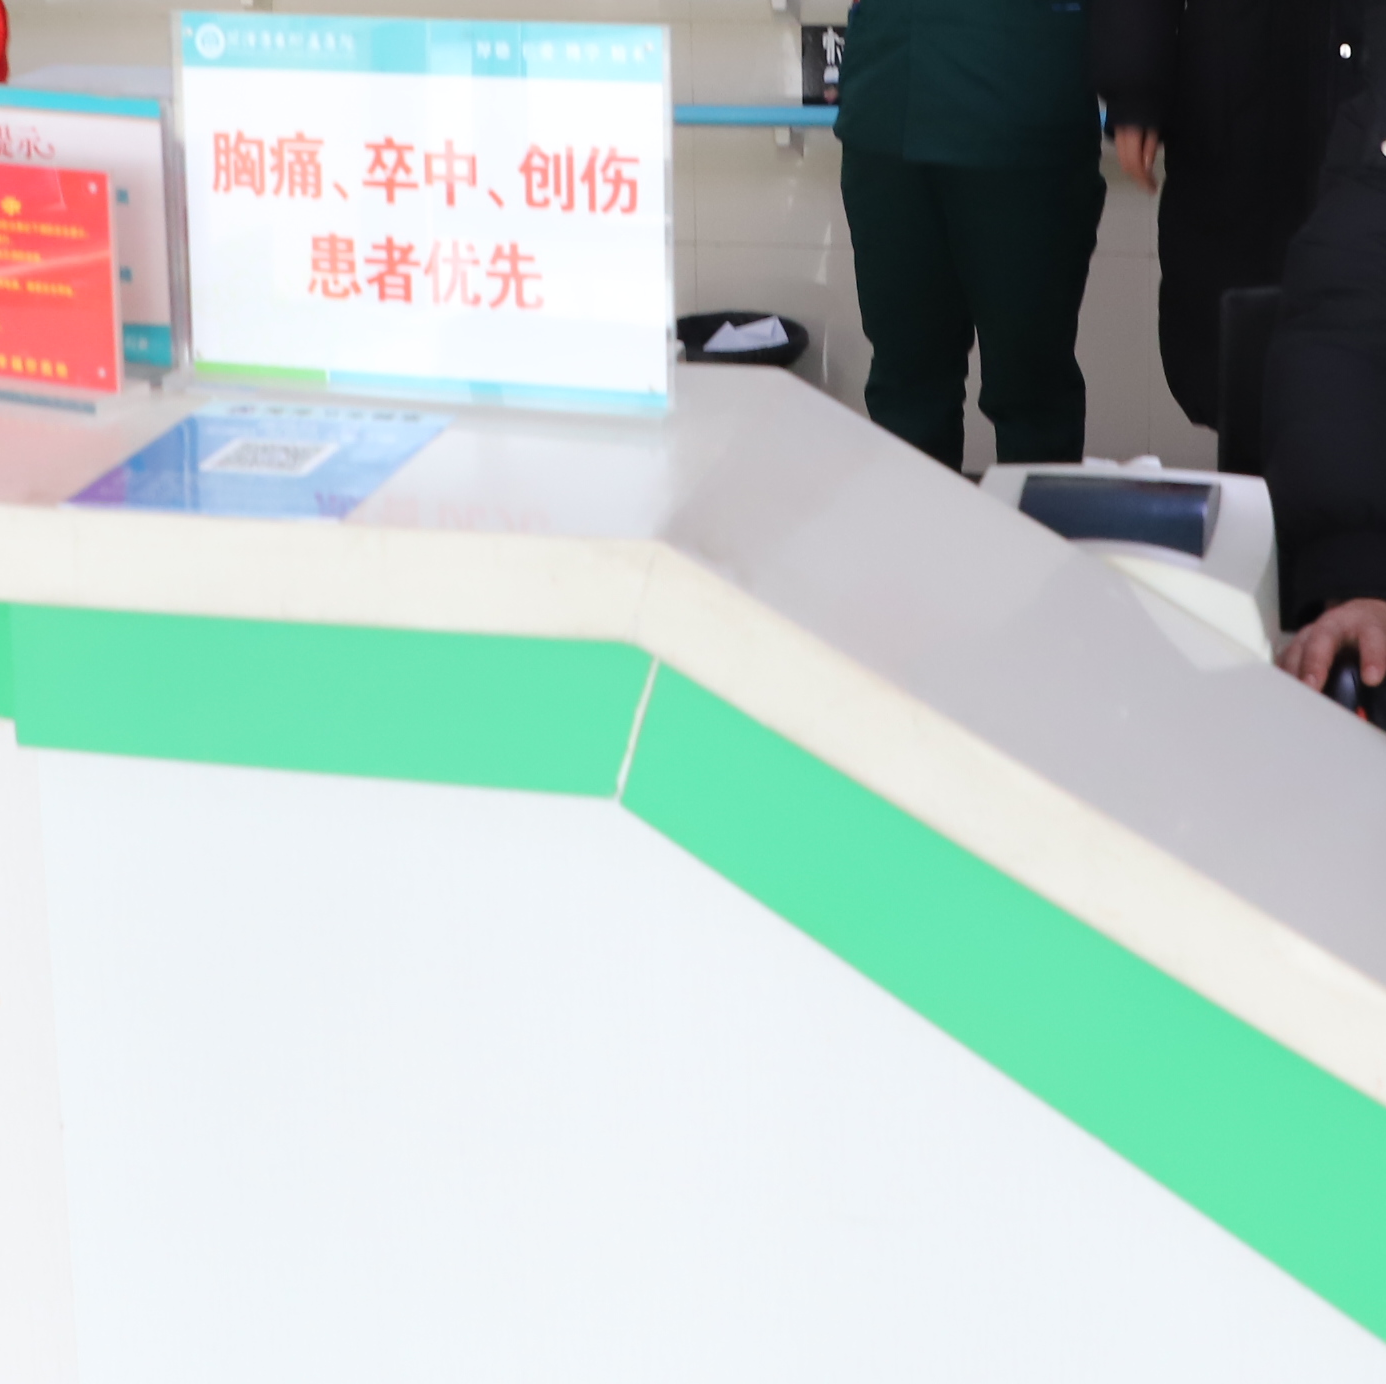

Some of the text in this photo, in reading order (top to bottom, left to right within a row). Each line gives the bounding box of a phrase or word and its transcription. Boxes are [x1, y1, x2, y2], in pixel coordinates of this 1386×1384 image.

[212, 129, 641, 215] 胸痛、卒中、创伤
[308, 232, 545, 311] 患者优先
